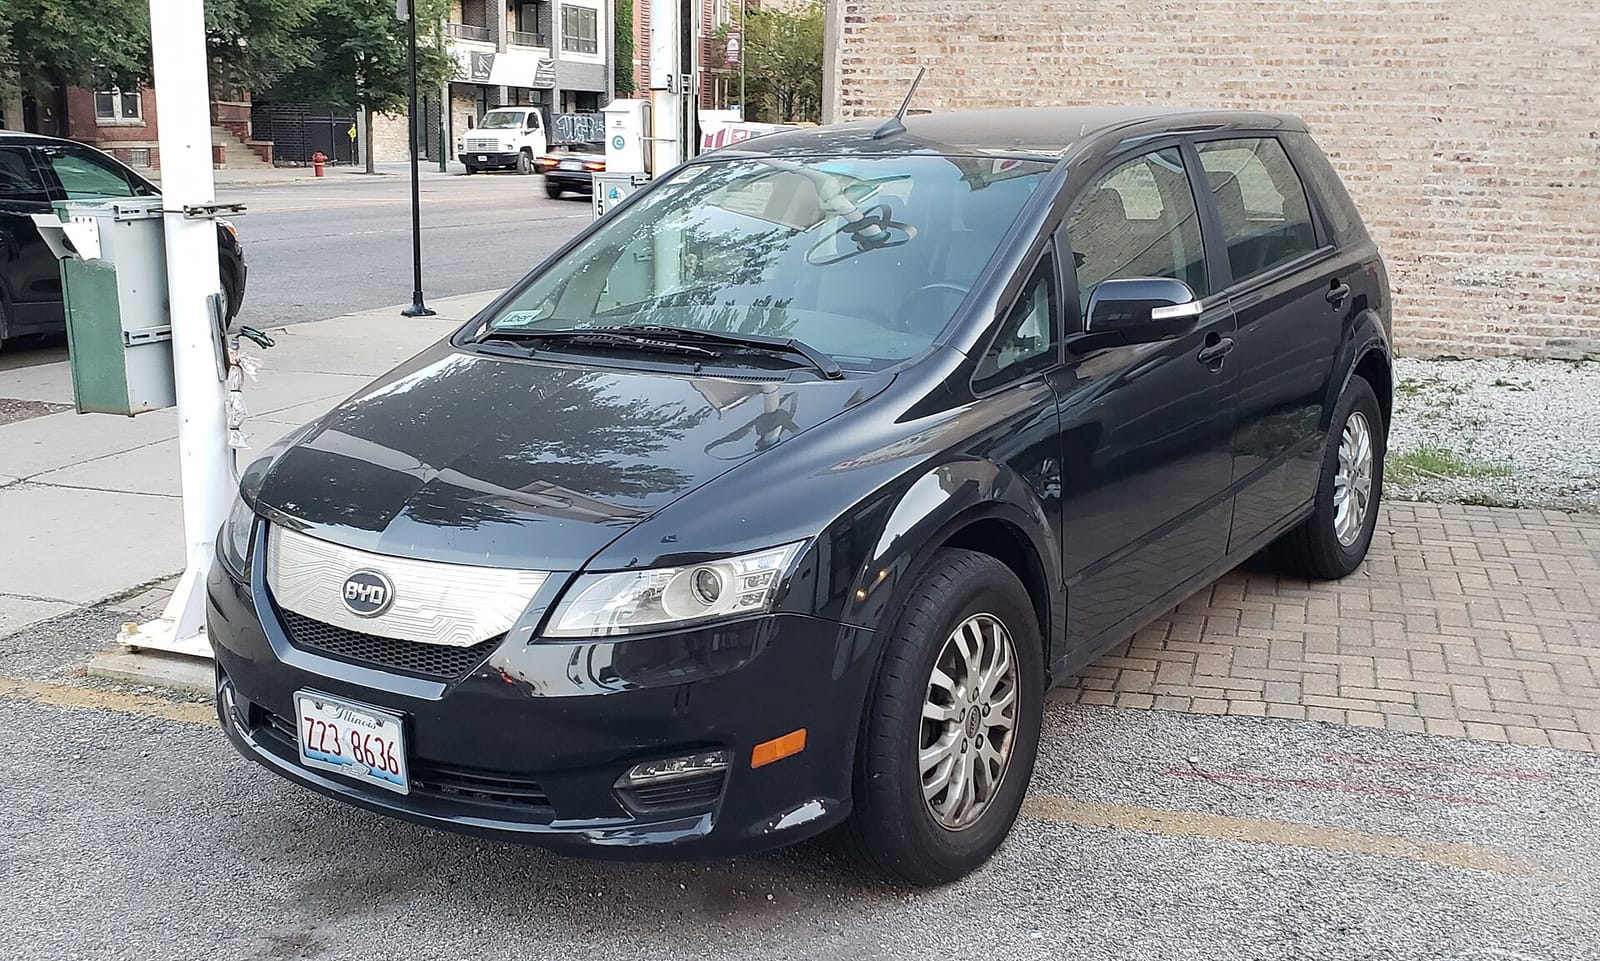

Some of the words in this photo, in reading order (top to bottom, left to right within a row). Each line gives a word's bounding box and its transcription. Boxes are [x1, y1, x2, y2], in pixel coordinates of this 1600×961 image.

[345, 581, 385, 605] BYD
[322, 705, 377, 730] Illinois
[303, 717, 342, 756] Z23
[350, 730, 399, 775] 8636
